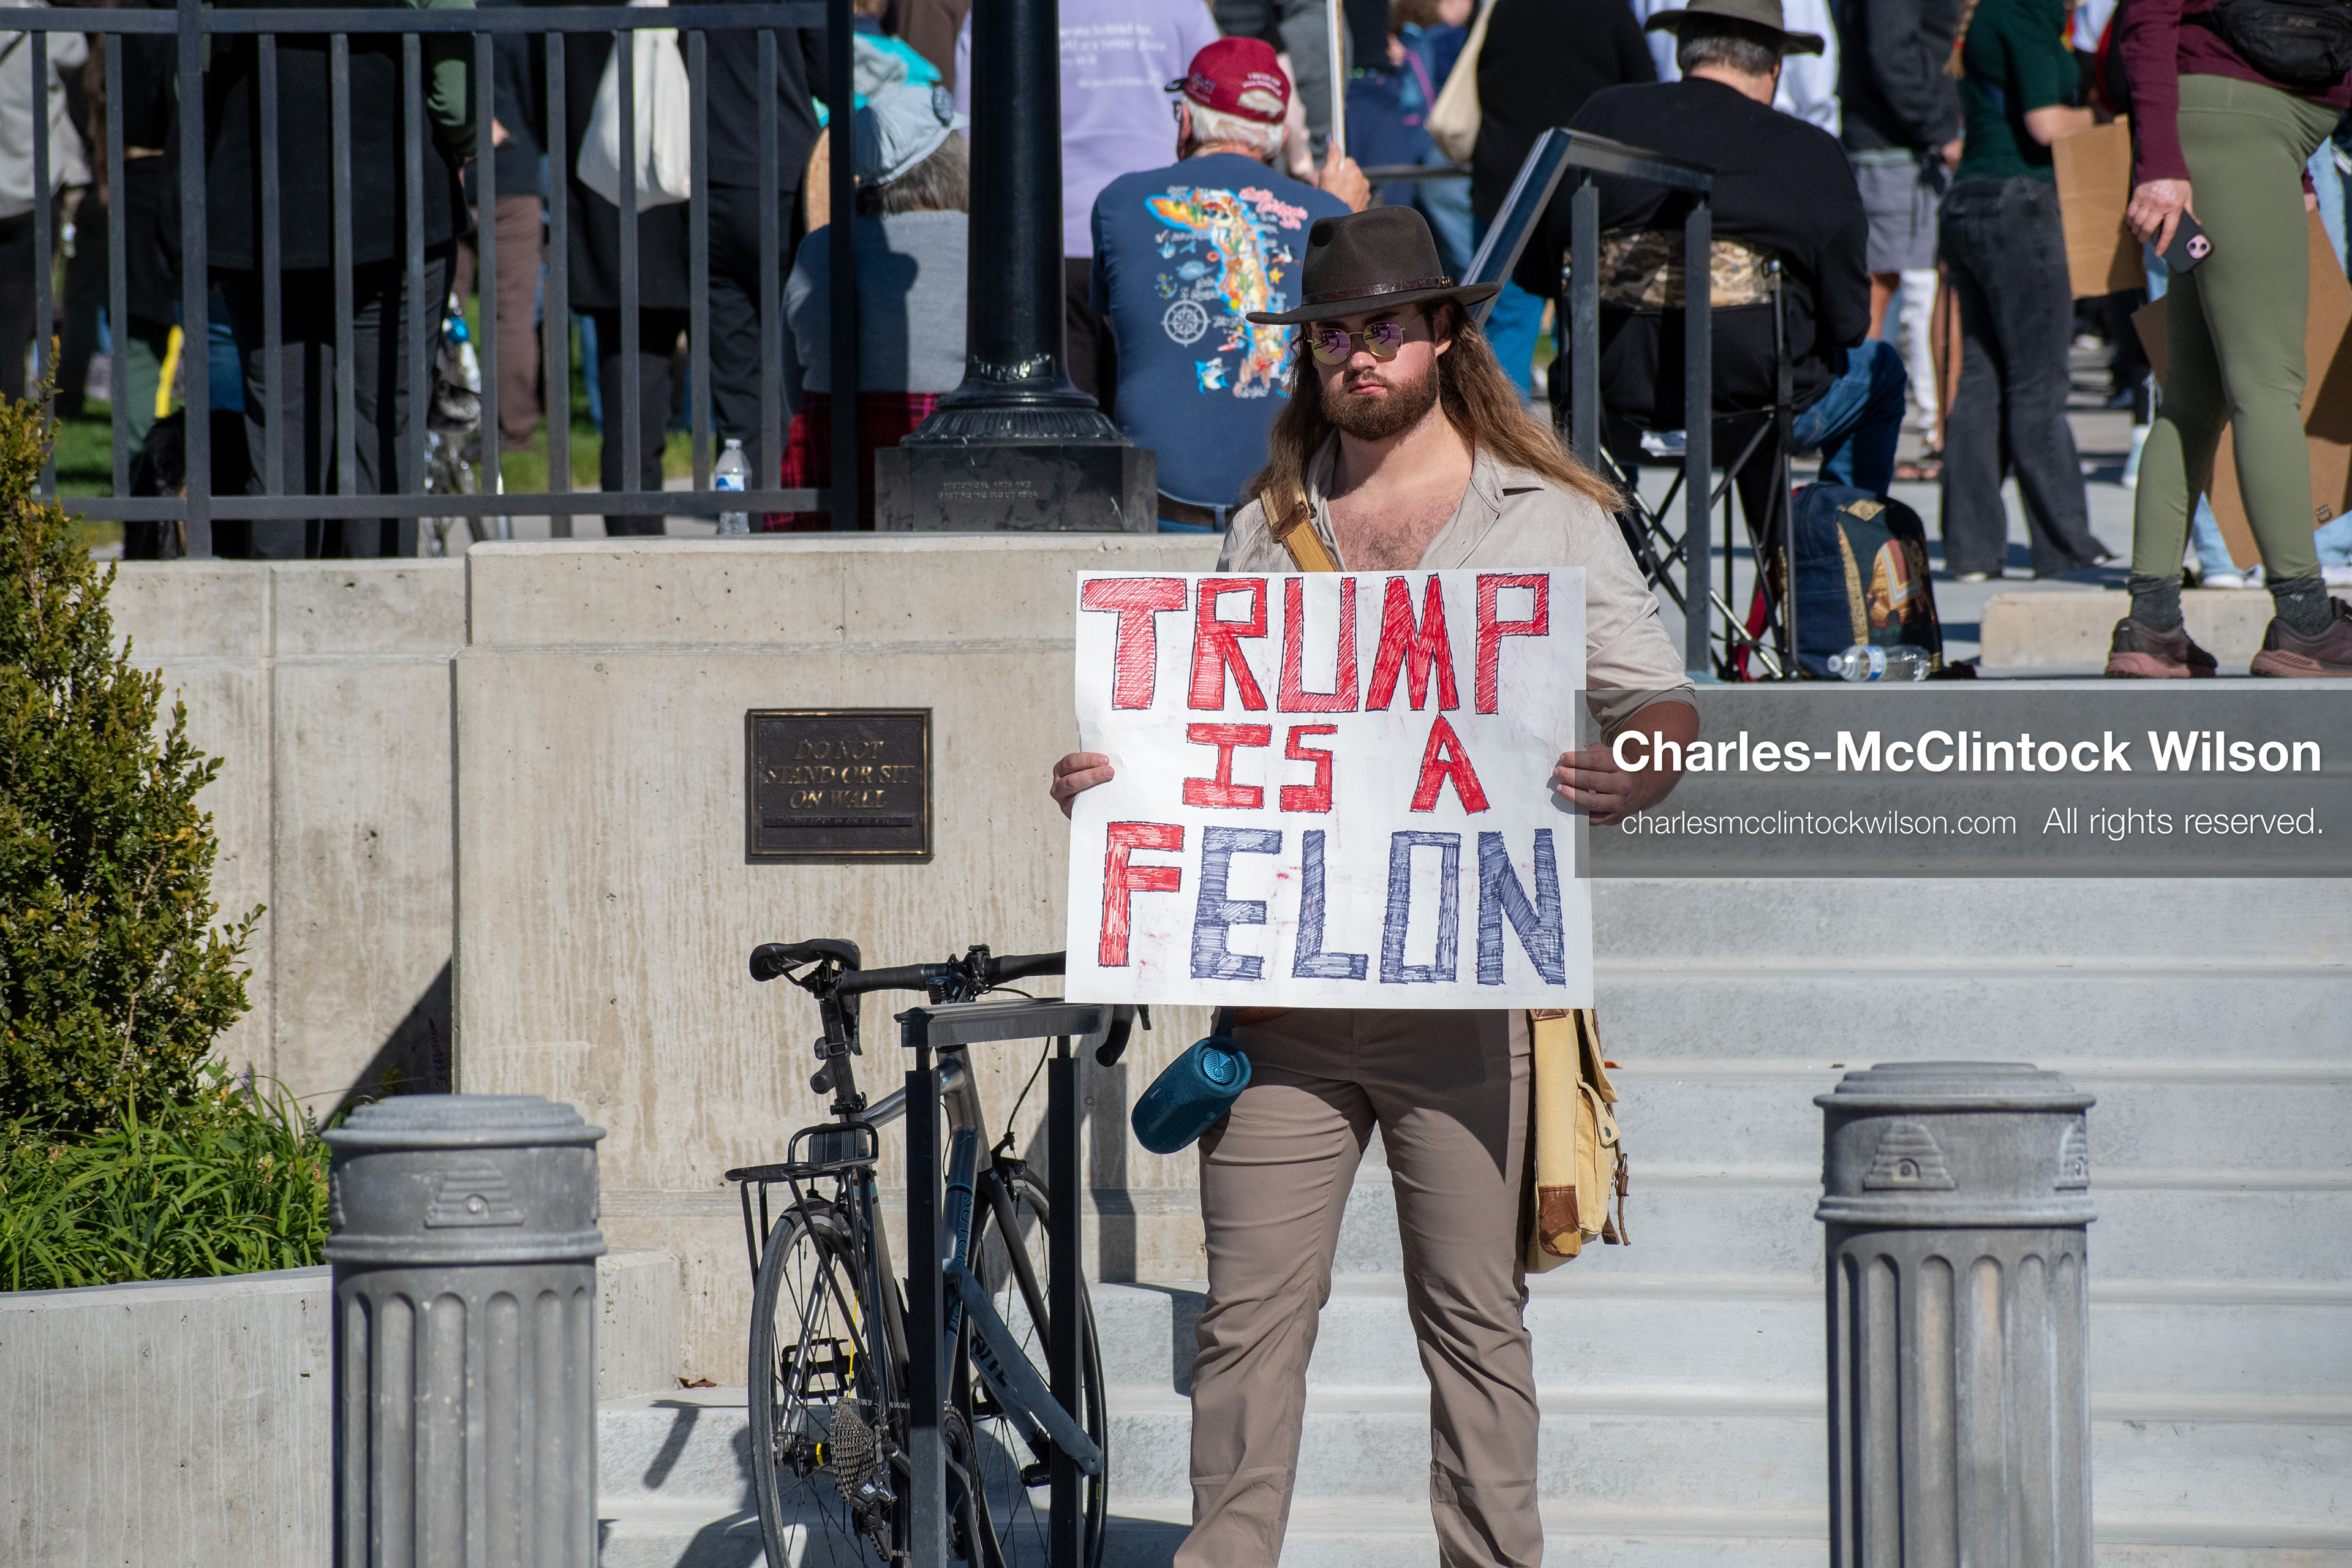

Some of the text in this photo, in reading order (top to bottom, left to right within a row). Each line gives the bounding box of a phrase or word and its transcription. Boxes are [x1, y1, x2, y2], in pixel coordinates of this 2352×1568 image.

[1080, 572, 1550, 714] TRUMP
[764, 764, 916, 785] STAND OR SIT
[793, 741, 885, 760] DO NOT
[1182, 712, 1490, 815] IS A
[790, 789, 889, 809] ON WALL
[1098, 821, 1567, 986] FELON
